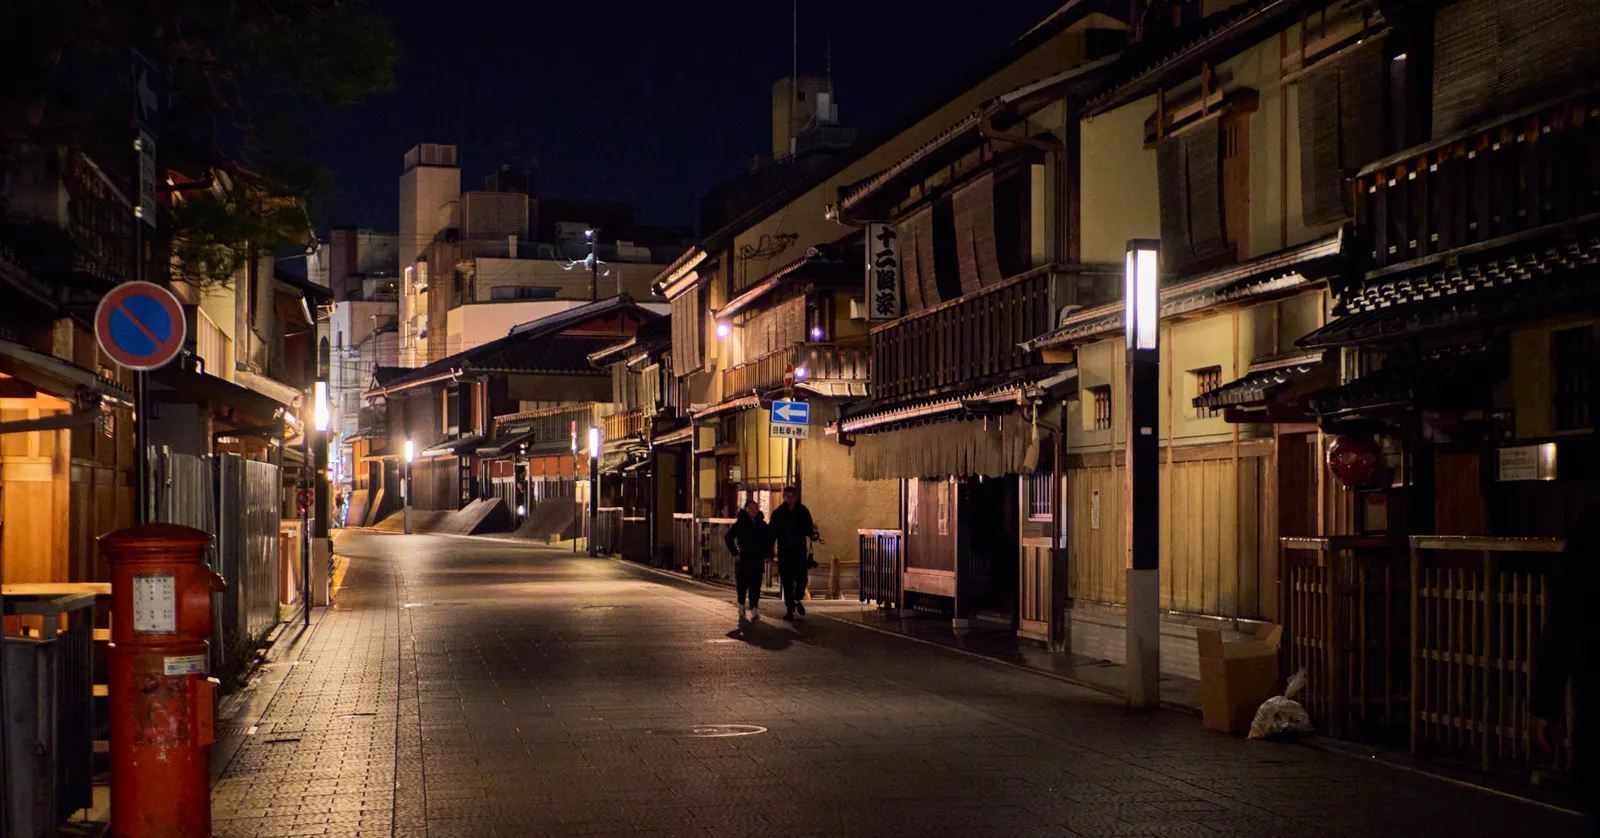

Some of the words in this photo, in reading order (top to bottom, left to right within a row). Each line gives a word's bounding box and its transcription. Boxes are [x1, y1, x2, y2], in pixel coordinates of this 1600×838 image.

[772, 425, 807, 436] 自転車を除く
